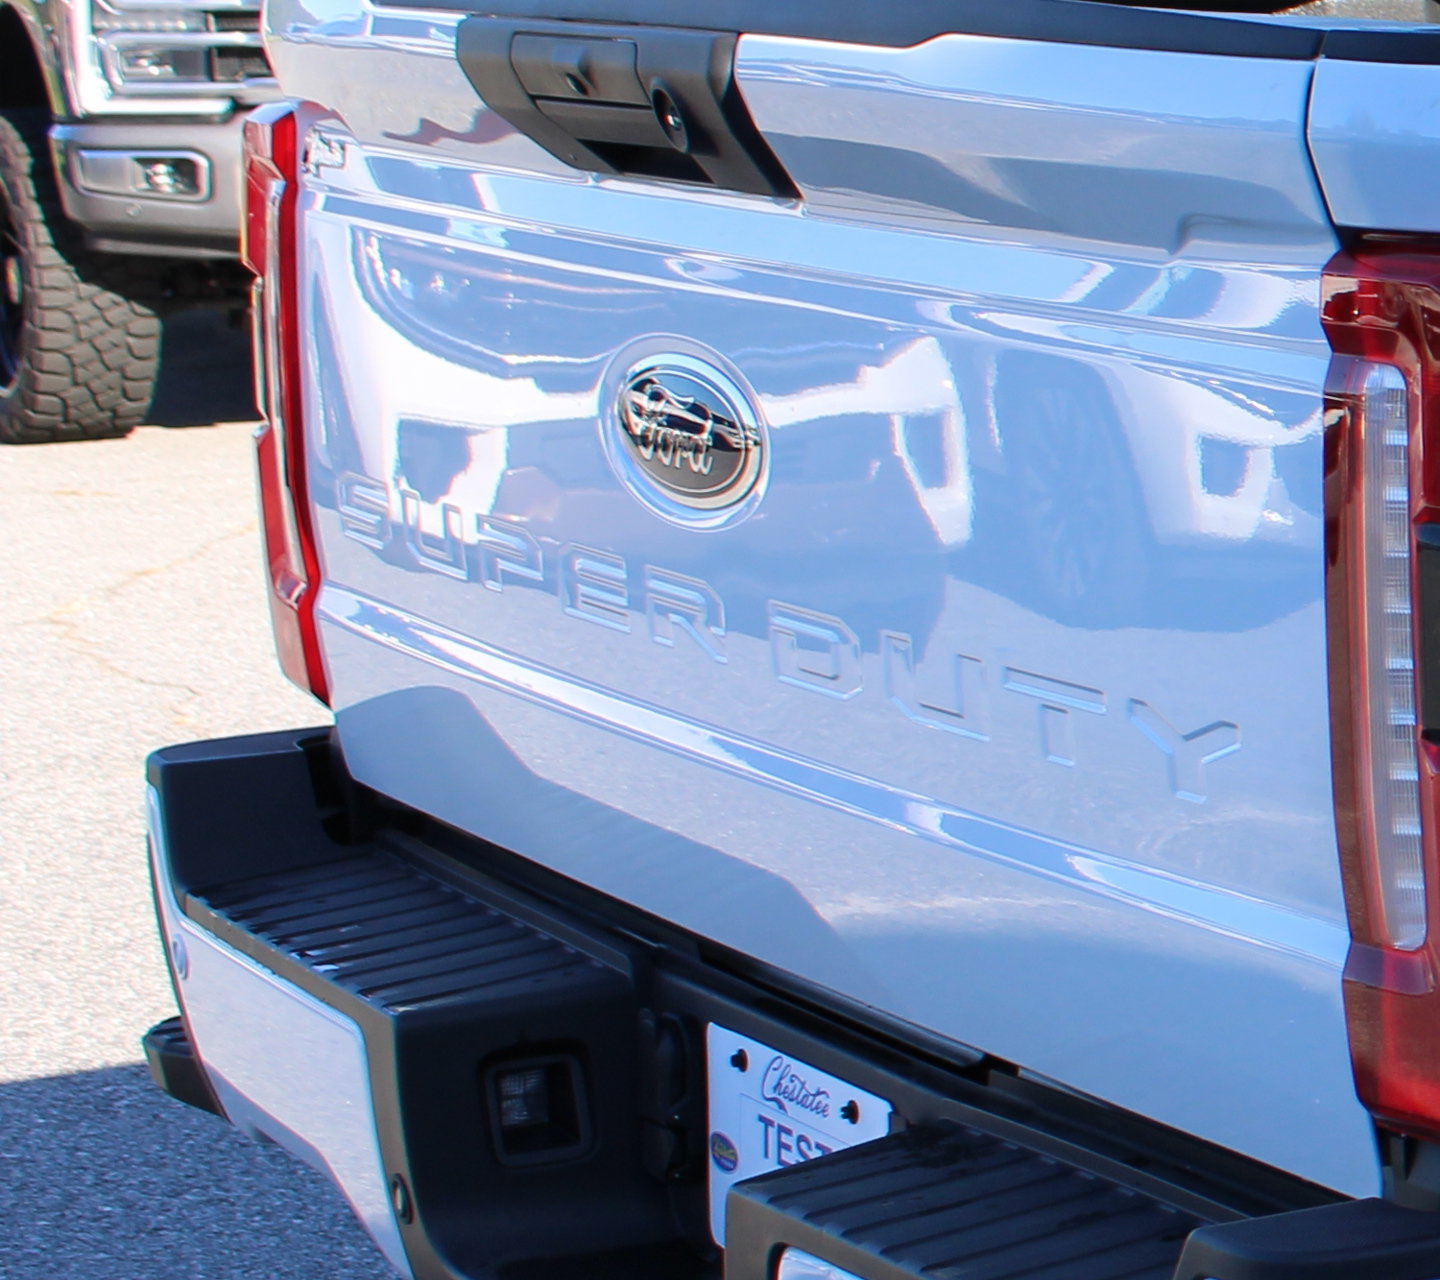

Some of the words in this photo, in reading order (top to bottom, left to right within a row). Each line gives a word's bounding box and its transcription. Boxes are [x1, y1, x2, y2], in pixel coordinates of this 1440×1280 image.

[622, 380, 713, 476] Ford
[336, 470, 730, 666] SUPER
[767, 598, 1244, 805] DUTY
